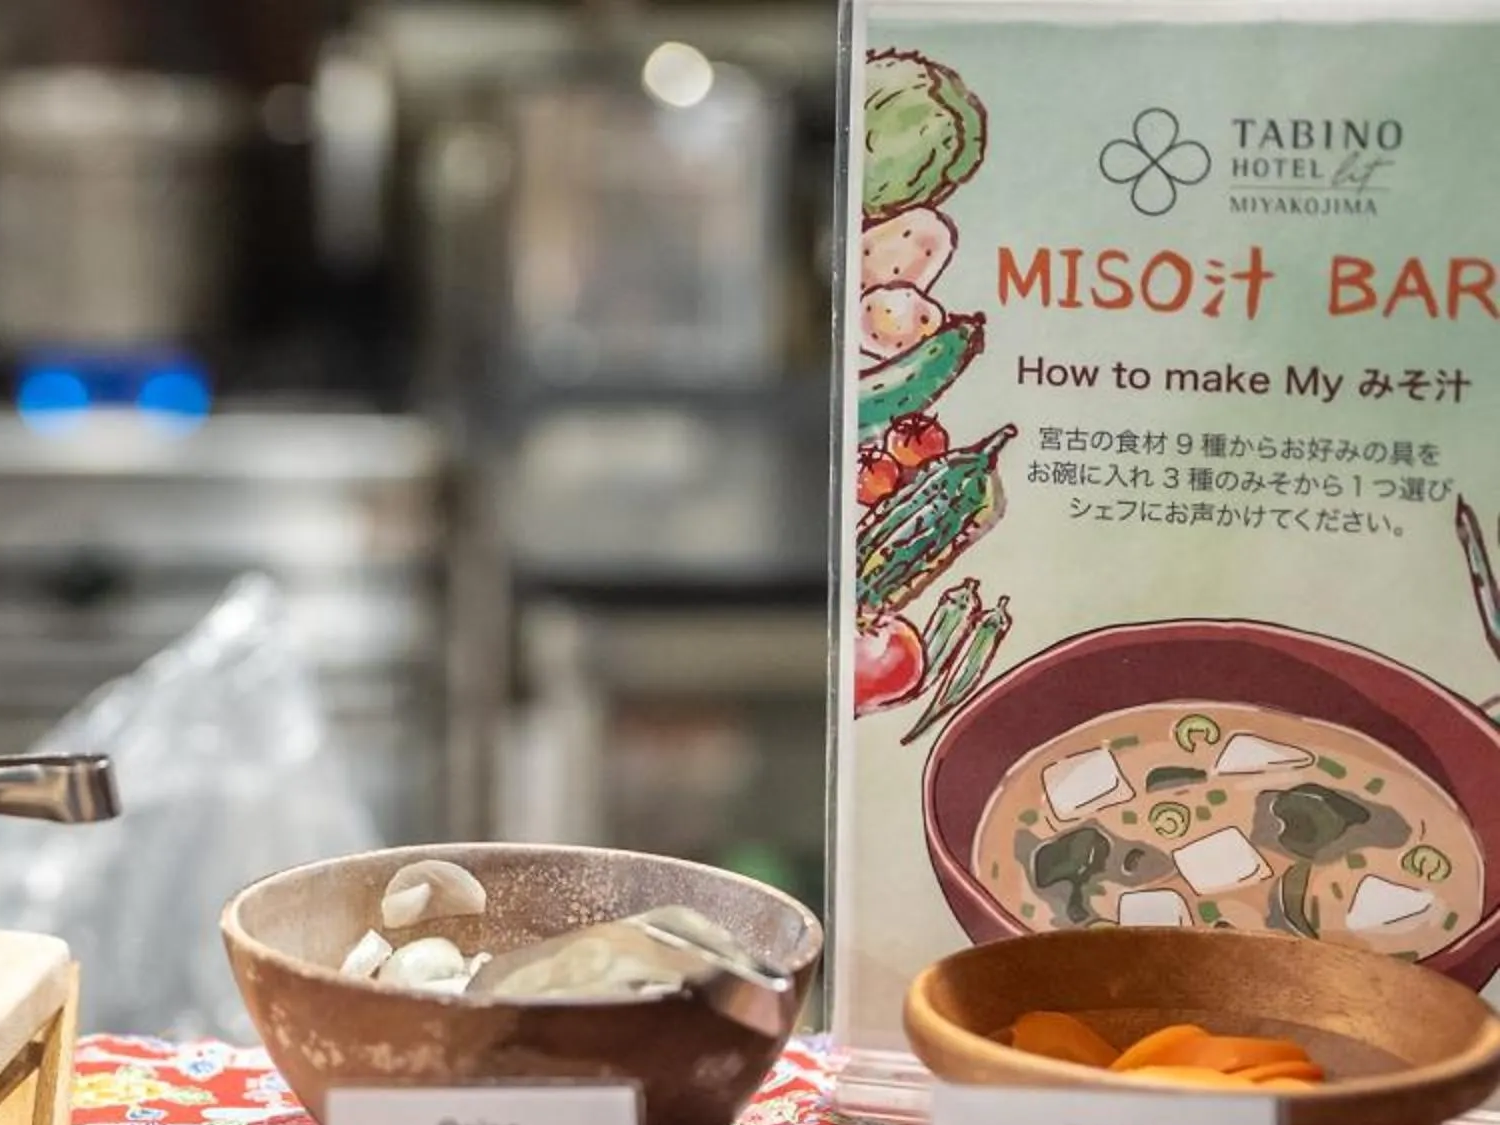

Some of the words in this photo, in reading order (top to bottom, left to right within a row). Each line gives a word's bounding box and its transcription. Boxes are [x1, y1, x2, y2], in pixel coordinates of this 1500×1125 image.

[1231, 117, 1404, 151] TABINO
[1231, 157, 1325, 180] HOTEL
[1229, 196, 1379, 217] MIYAKOJIMA
[997, 245, 1276, 321] MISO汁
[1327, 254, 1500, 321] BAR
[1017, 355, 1100, 388] How
[1112, 361, 1151, 391] to
[1164, 364, 1271, 396] make
[1285, 366, 1345, 403] My
[1357, 368, 1473, 404] みそ汁
[1068, 496, 1404, 538] シェフにお声かけてください。
